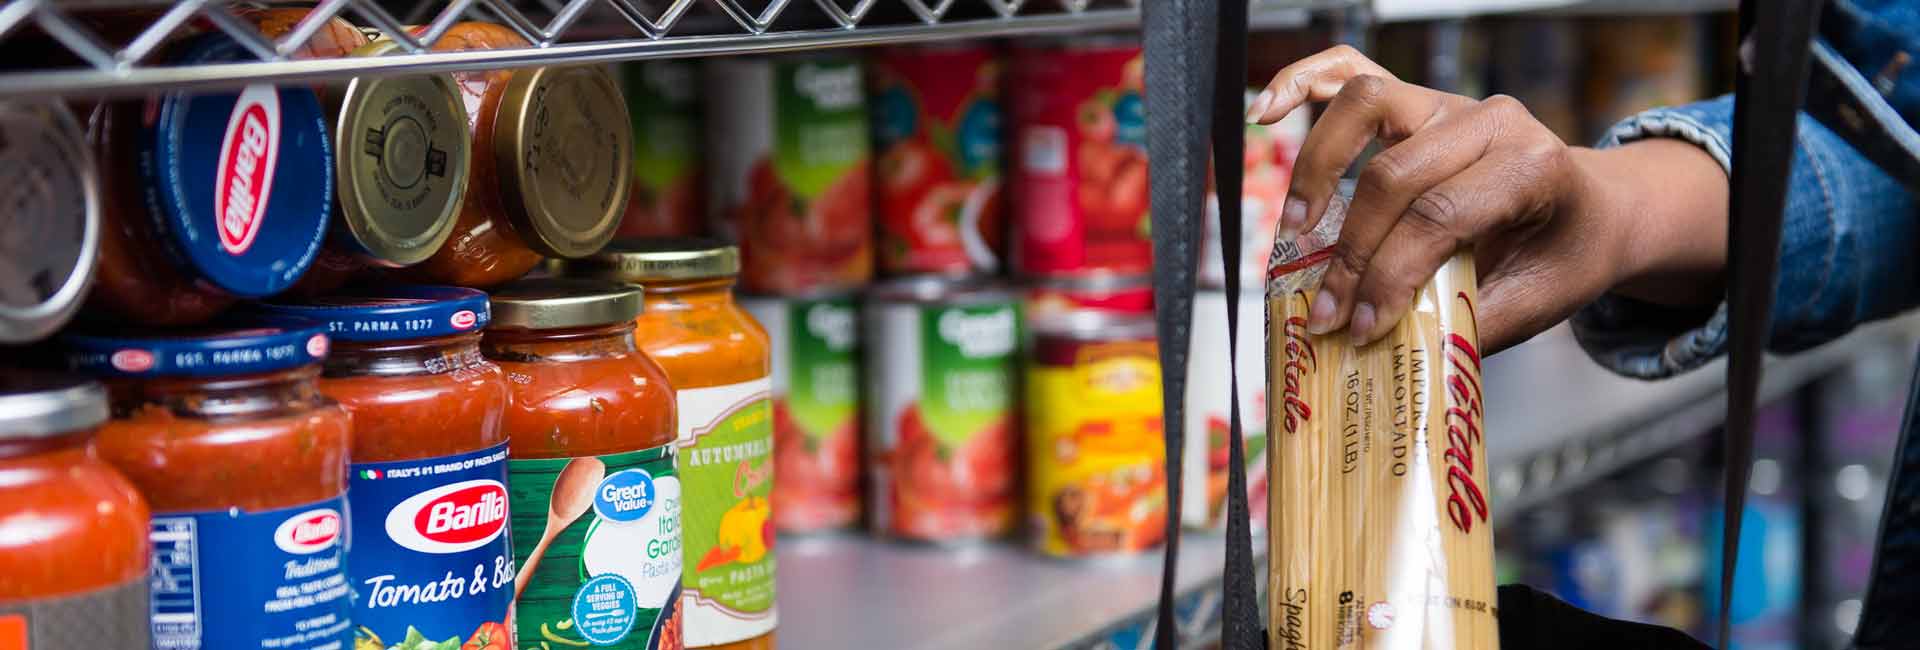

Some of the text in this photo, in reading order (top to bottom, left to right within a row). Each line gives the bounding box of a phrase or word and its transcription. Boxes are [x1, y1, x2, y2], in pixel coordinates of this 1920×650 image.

[223, 111, 267, 239] Barilla
[329, 319, 433, 332] ST. PARMA 1877
[1284, 288, 1317, 435] Vitale
[1347, 369, 1359, 389] 16
[1392, 343, 1407, 477] IMPORTADO
[1443, 291, 1488, 535] Vitale
[434, 461, 464, 474] BRAND
[464, 459, 474, 468] OF
[602, 480, 647, 503] Great
[426, 491, 505, 534] Barilla
[614, 498, 647, 513] Value
[364, 571, 465, 608] Tomato
[469, 564, 488, 595] &
[601, 583, 616, 592] FULL
[585, 593, 617, 603] SERVING
[592, 600, 620, 610] VEGGIES
